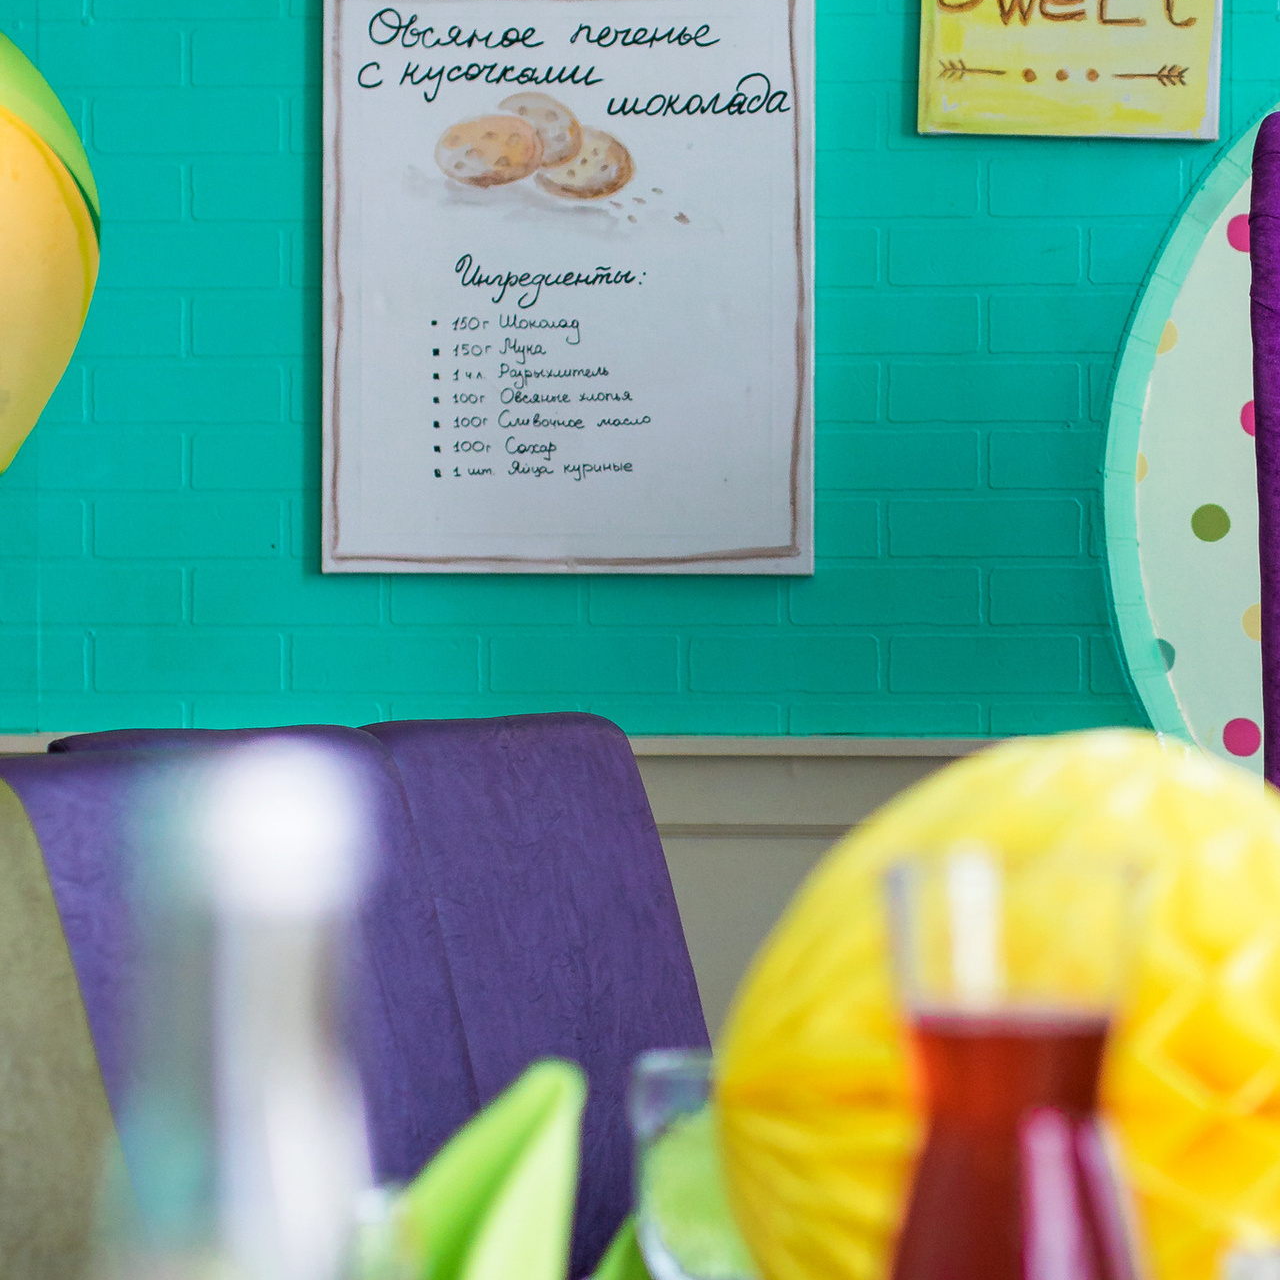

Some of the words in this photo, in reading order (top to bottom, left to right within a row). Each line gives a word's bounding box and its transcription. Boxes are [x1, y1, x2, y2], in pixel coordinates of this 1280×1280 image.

[368, 7, 544, 49] Овсяное
[570, 23, 721, 48] печенье
[399, 60, 604, 102] кусочками
[606, 72, 791, 115] шоколада
[454, 253, 648, 309] Ингредиенты:
[499, 314, 581, 346] Шоколад
[499, 337, 547, 365] Мука
[452, 368, 460, 381] 1
[497, 362, 610, 390] Разрыхлитель
[452, 392, 486, 405] 100г
[579, 390, 633, 402] хлопья
[452, 415, 488, 429] 100г
[497, 408, 585, 429] Сливочное
[596, 414, 652, 428] масло
[452, 439, 492, 453] 100г
[504, 435, 558, 461] Сахар
[452, 465, 462, 477] 1
[507, 459, 555, 478] Яйца
[563, 461, 634, 482] куриные
